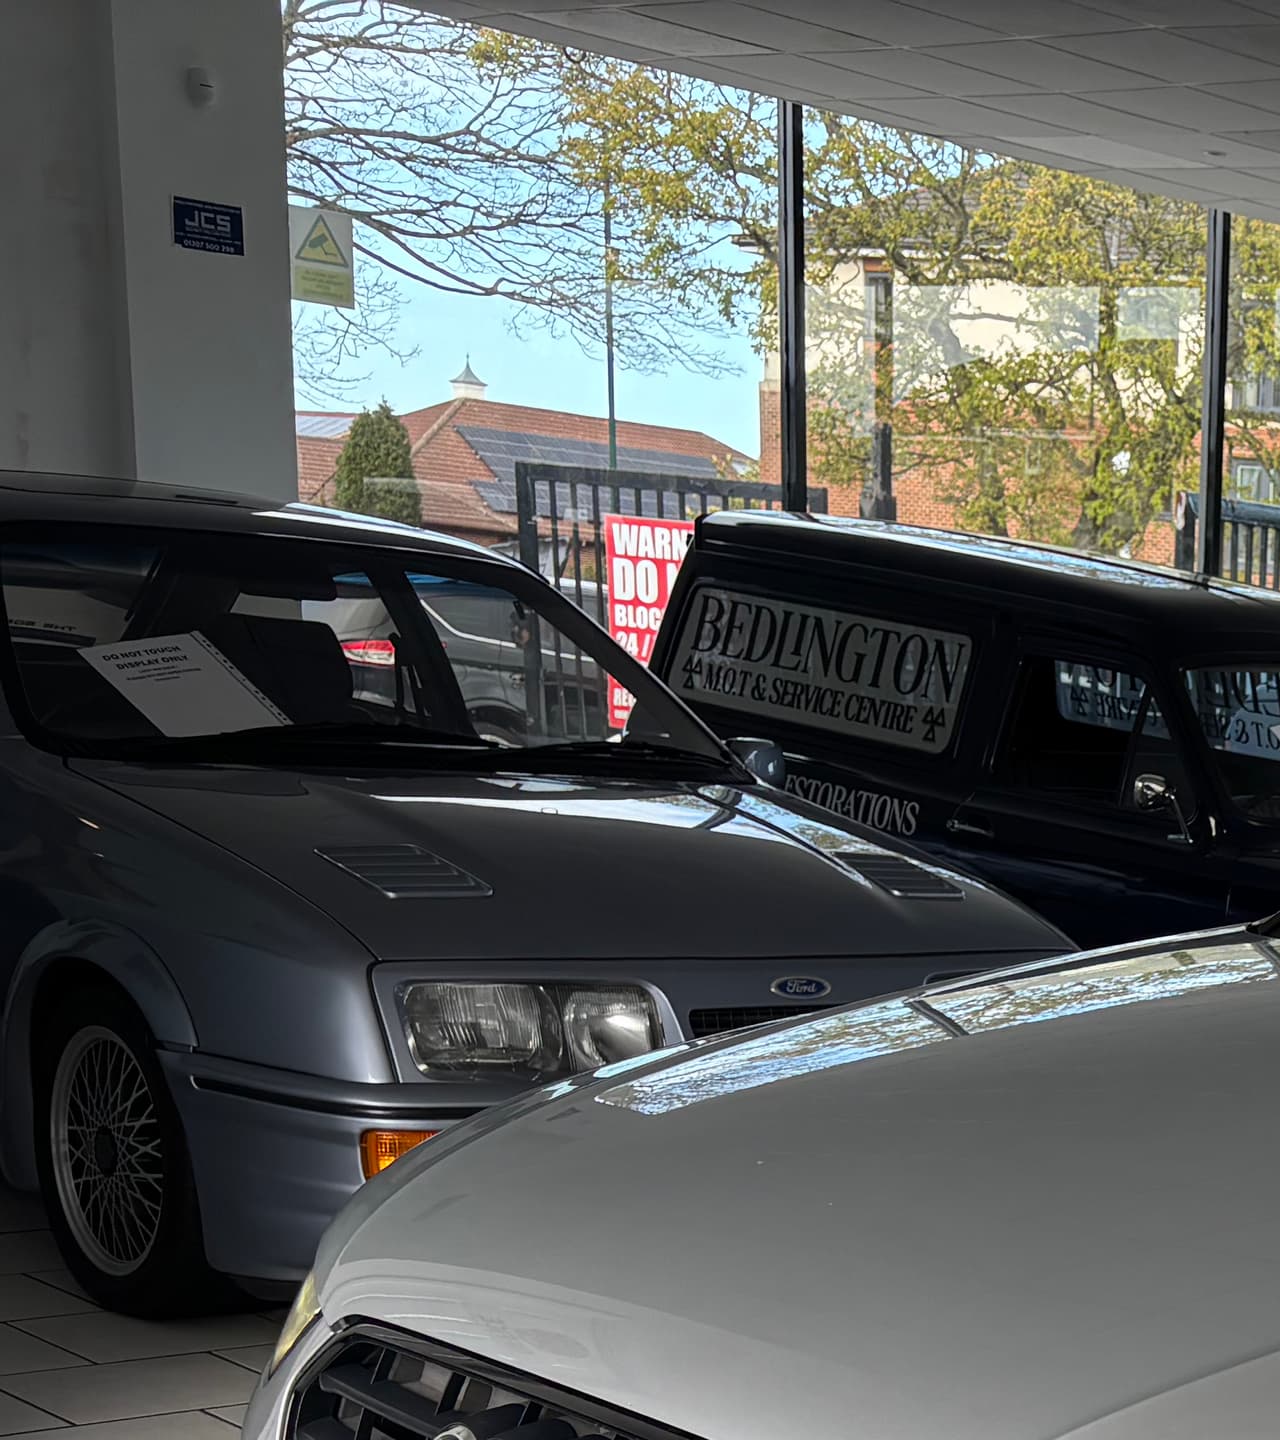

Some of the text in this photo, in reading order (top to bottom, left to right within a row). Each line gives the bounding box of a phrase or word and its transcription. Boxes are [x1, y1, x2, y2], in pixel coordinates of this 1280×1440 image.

[184, 210, 231, 233] JCS
[612, 523, 694, 561] WARN
[612, 557, 658, 604] DO
[614, 603, 662, 631] BLOC
[116, 654, 189, 671] DISPLAY ONLY
[120, 649, 143, 660] NOT
[142, 645, 182, 656] TOUCH
[690, 594, 966, 704] BEDLINGTON
[702, 662, 919, 735] M.O.T & SERVICE CENTRE
[784, 773, 920, 837] ESTORATIONS
[786, 979, 818, 993] Ford
